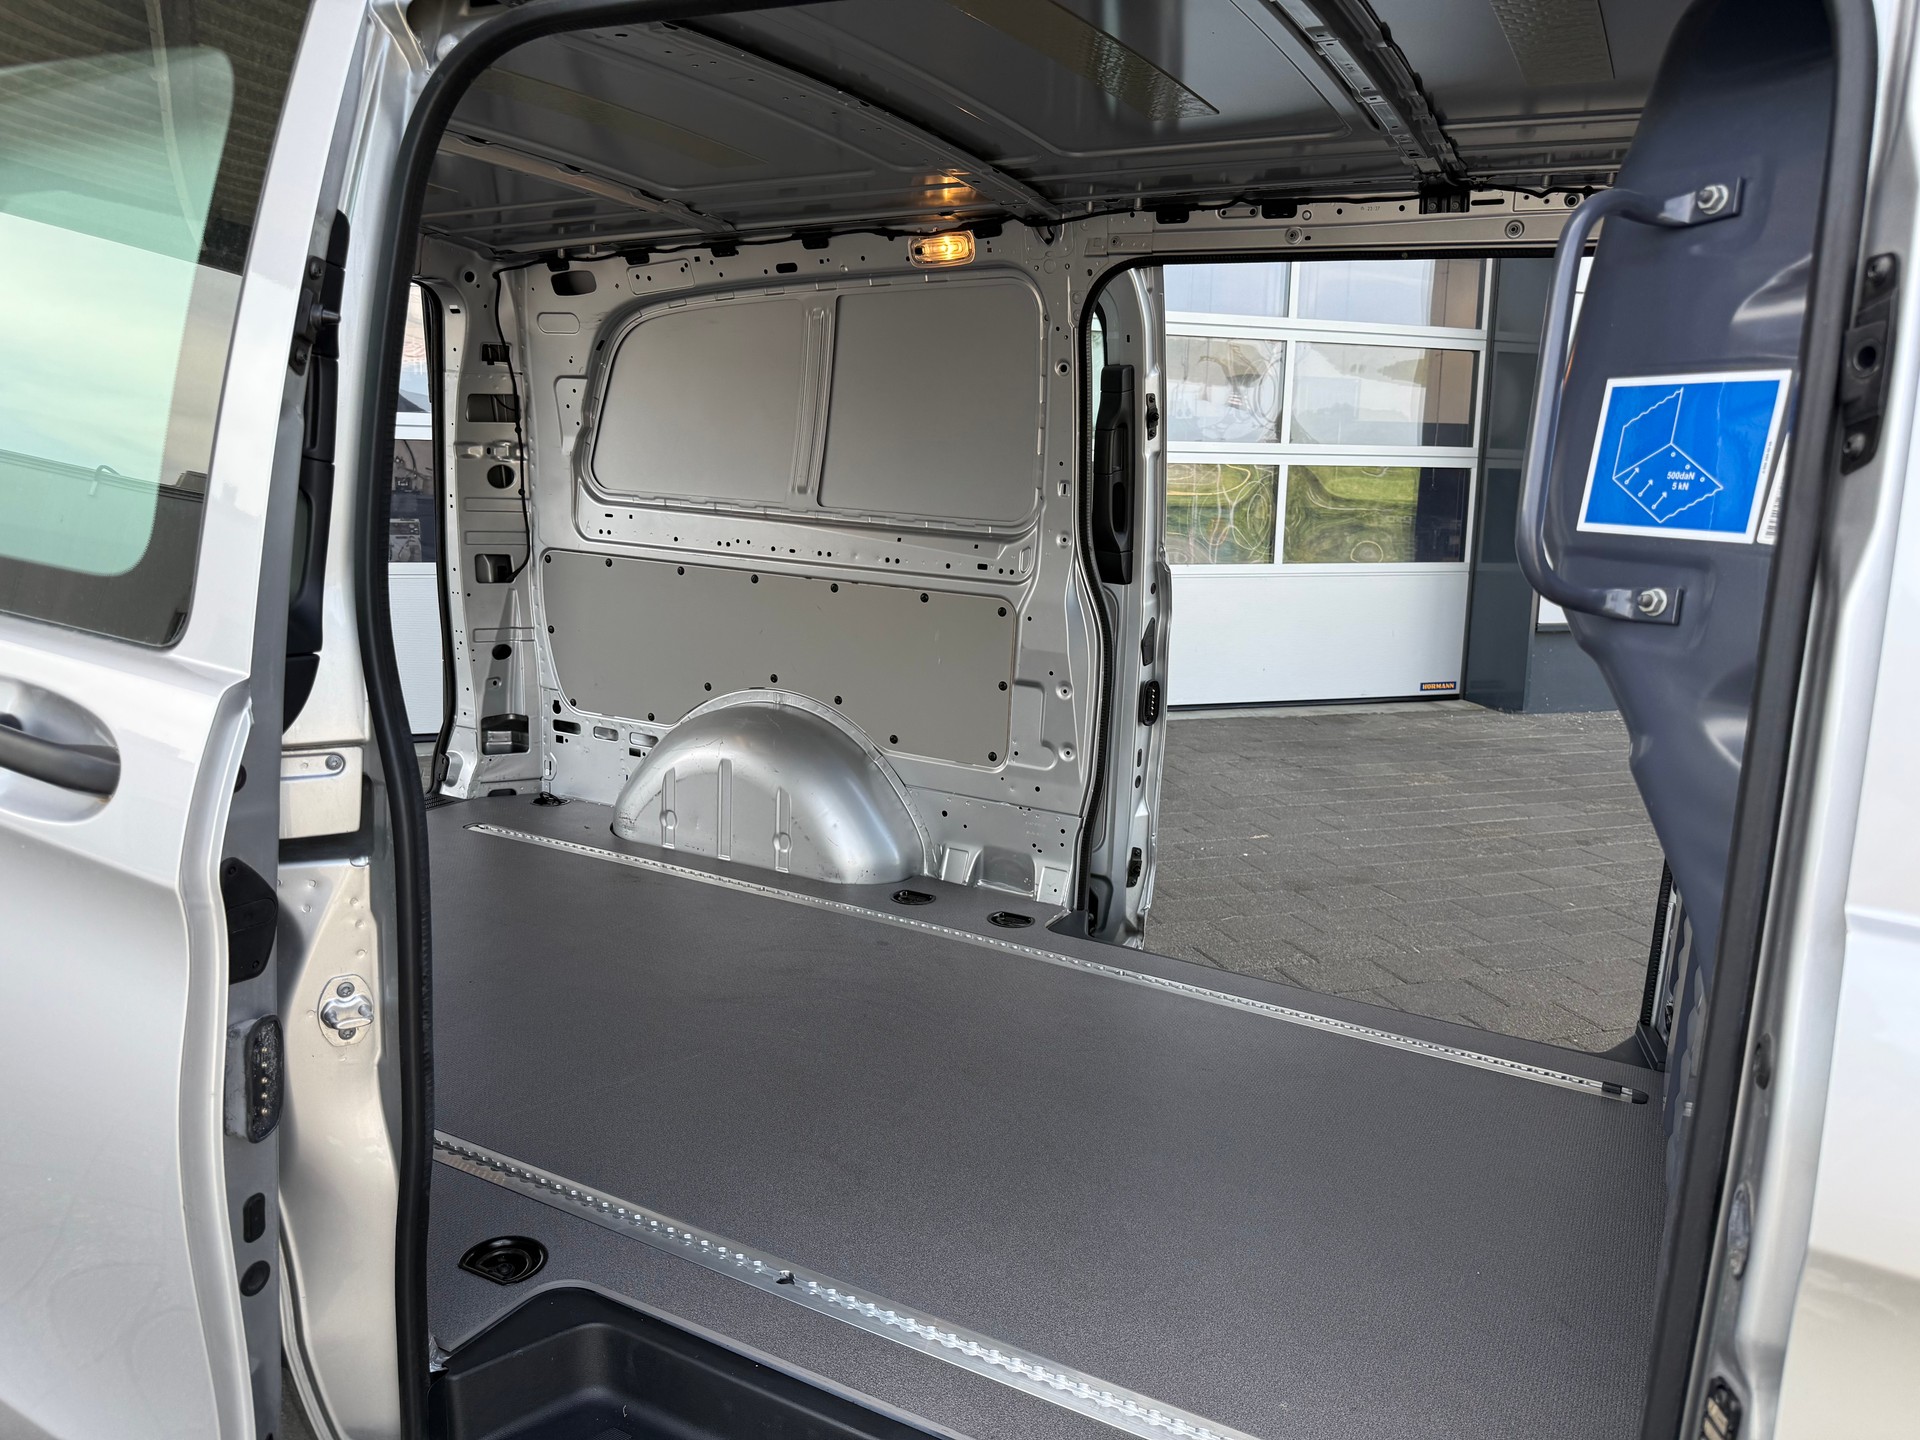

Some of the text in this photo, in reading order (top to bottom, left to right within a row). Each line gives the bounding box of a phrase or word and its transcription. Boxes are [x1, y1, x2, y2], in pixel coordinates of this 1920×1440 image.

[1667, 471, 1695, 480] 500daN
[1672, 482, 1689, 490] 5 kN
